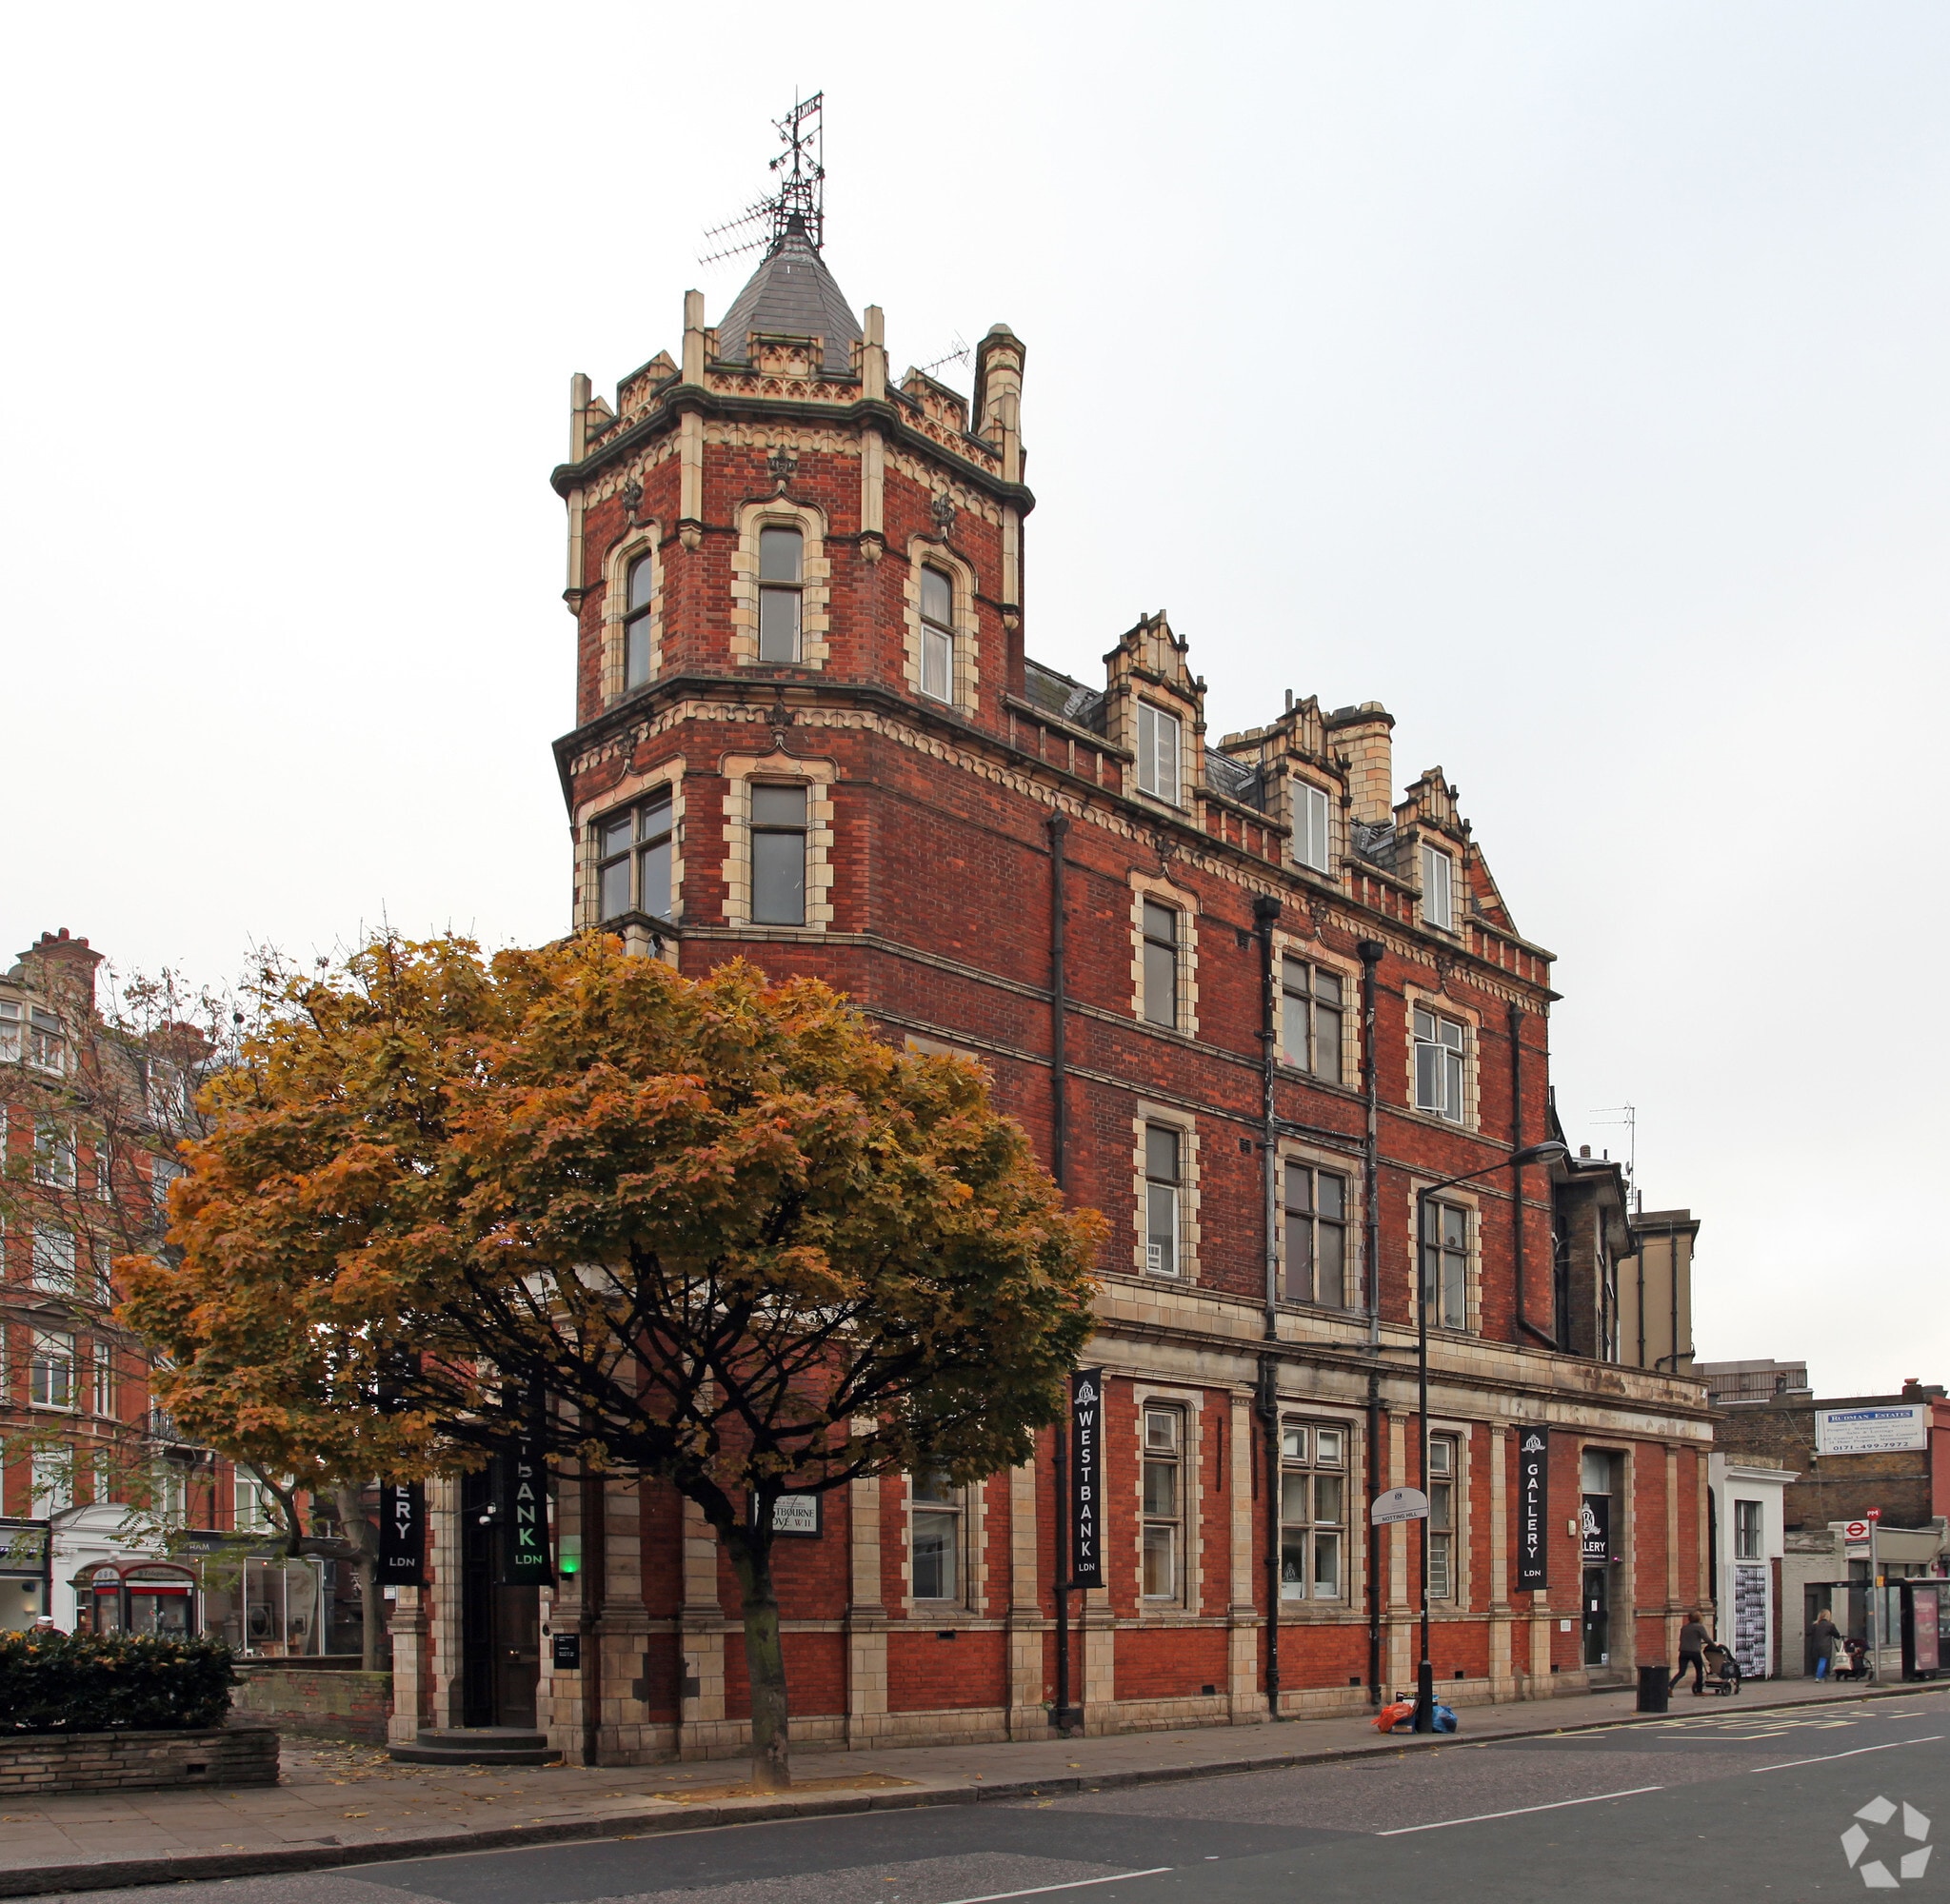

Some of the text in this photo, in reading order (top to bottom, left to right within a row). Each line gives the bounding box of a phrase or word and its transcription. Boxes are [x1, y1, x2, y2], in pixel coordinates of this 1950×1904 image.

[1078, 1410, 1094, 1557] WESTBANK
[1526, 1463, 1539, 1558] GALLERY
[389, 1557, 415, 1566] LDN
[515, 1555, 543, 1564] LDN
[1079, 1563, 1095, 1572] LDN
